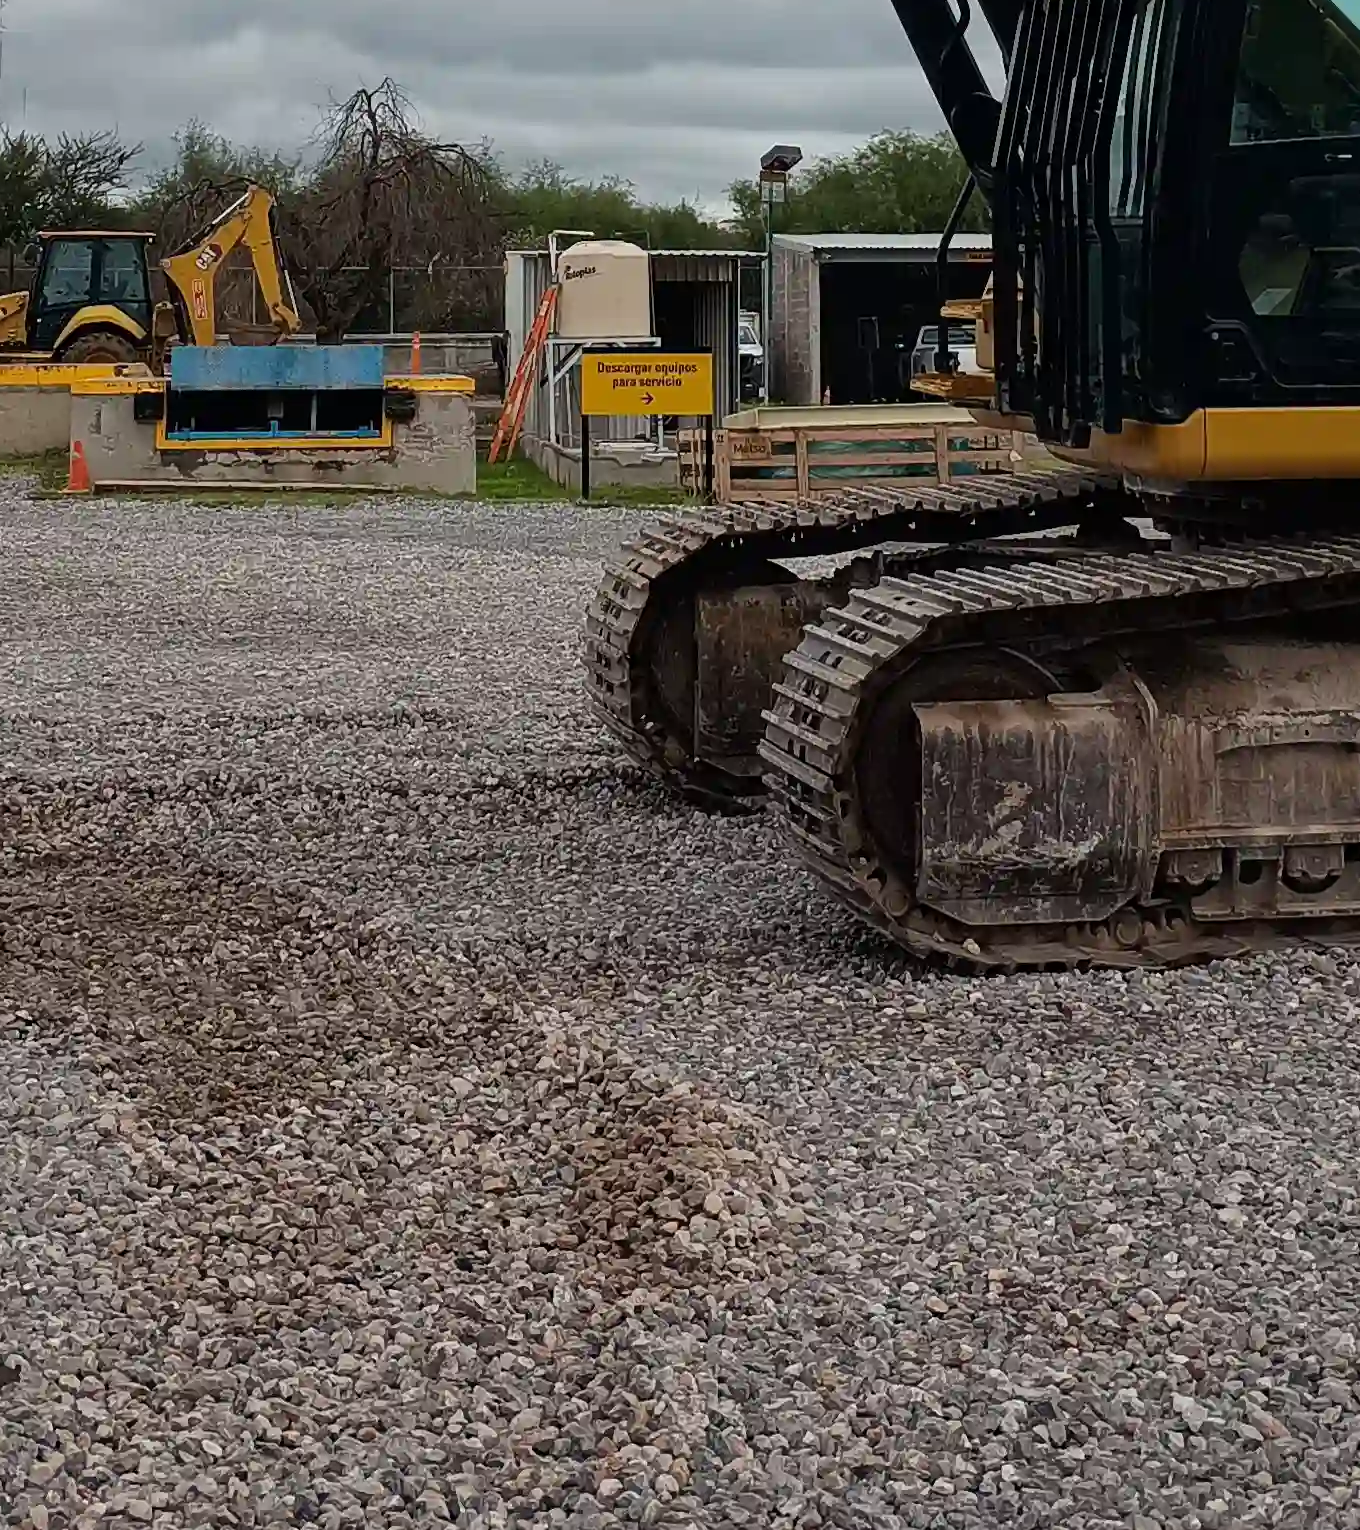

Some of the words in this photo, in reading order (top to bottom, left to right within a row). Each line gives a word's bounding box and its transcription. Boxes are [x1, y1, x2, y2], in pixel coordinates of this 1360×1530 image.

[195, 245, 217, 270] CAT
[597, 361, 652, 375] Descargar
[654, 361, 698, 375] equipos
[613, 377, 637, 389] para
[638, 375, 682, 387] servicio
